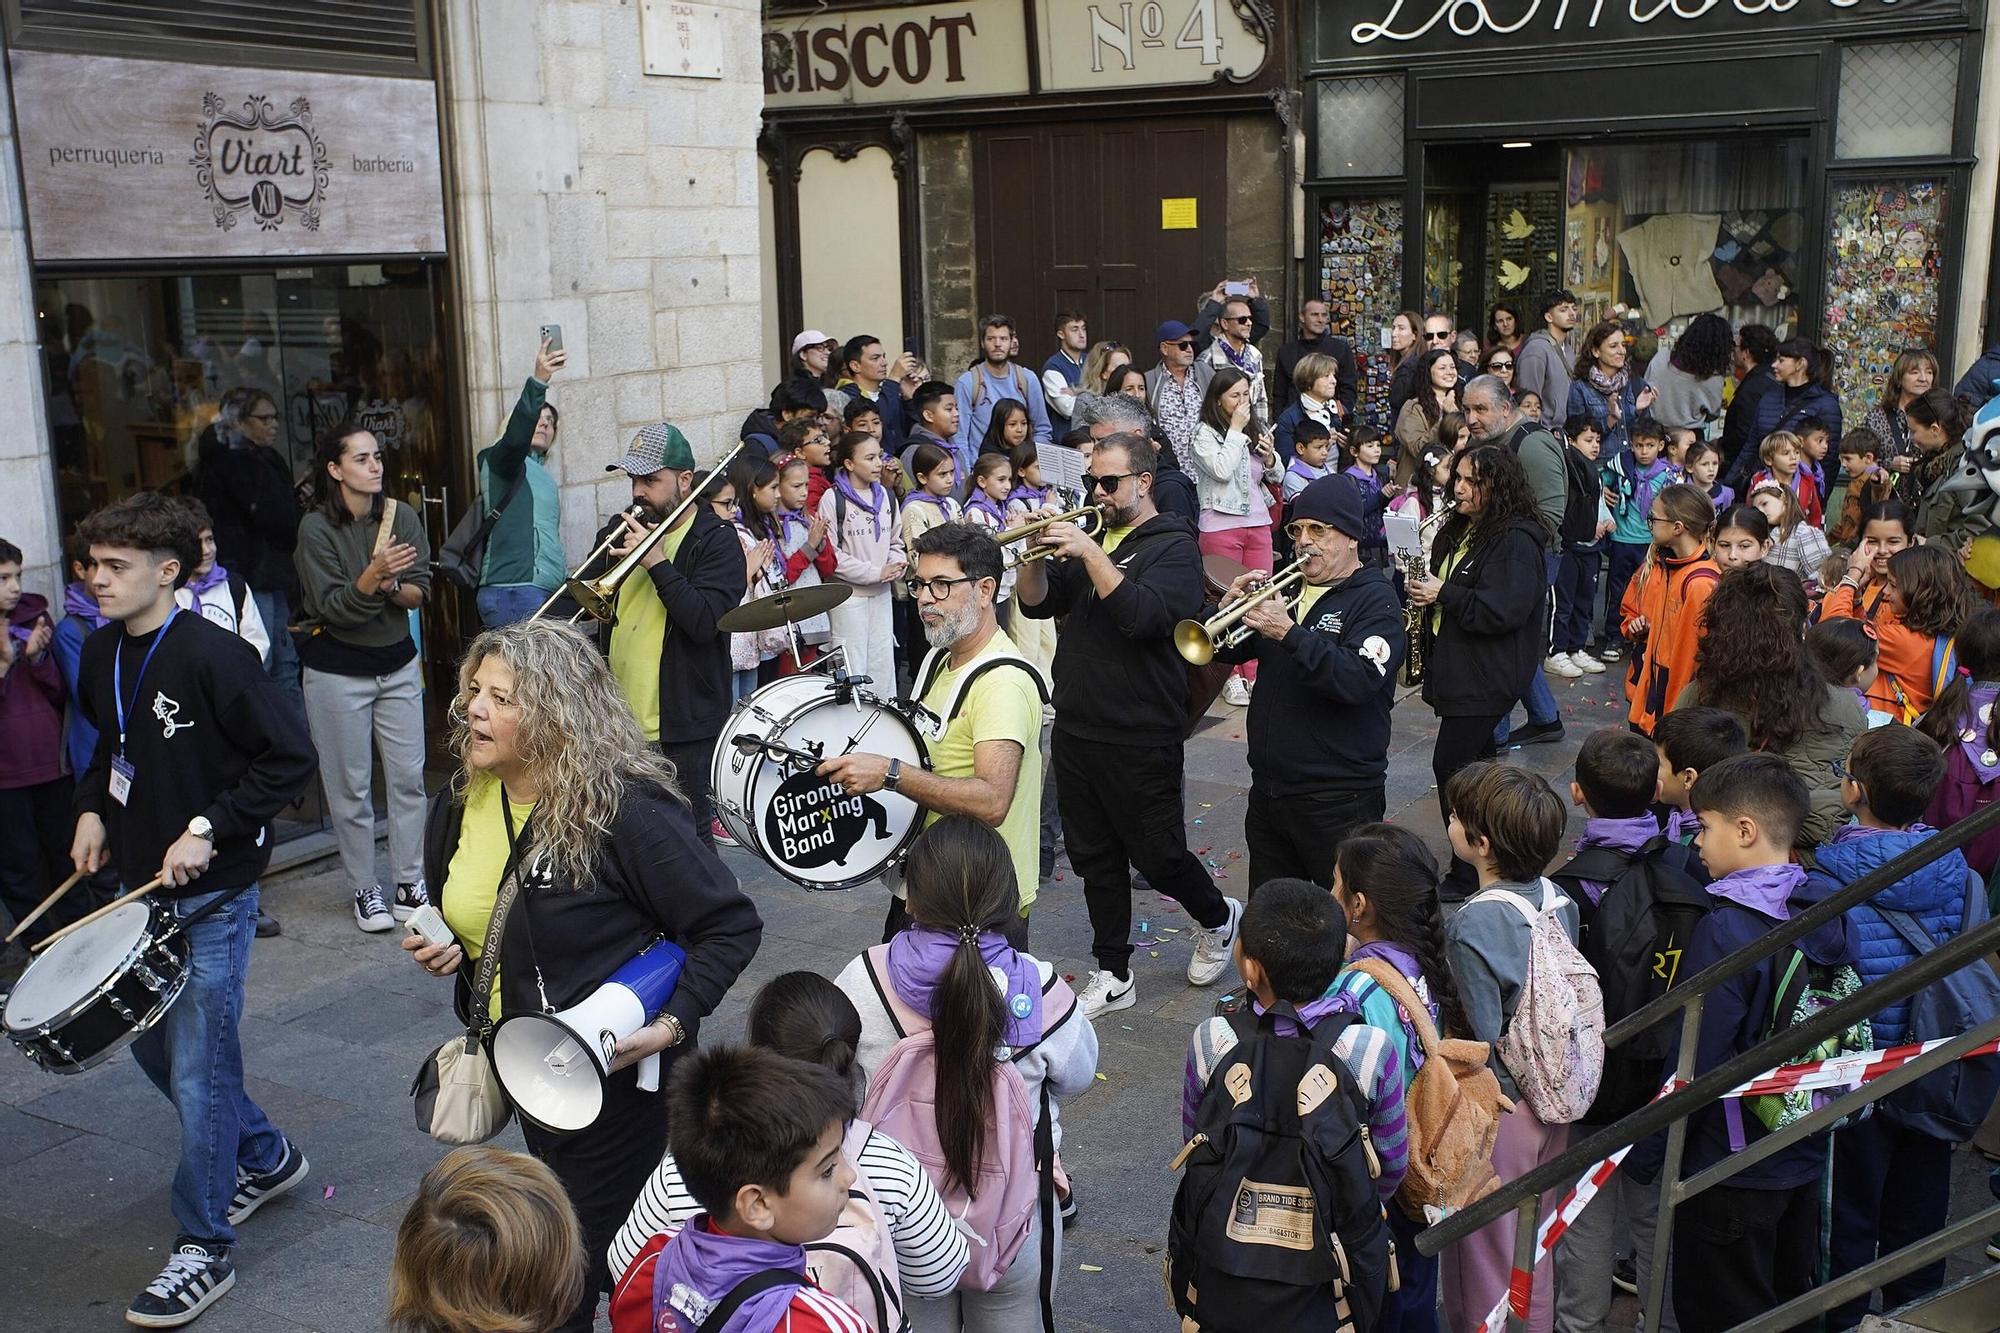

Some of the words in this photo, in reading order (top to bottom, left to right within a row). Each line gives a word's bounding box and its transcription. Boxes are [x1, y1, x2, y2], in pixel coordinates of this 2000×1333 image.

[49, 145, 164, 168] perruqueria
[221, 139, 305, 176] Viart
[352, 154, 414, 173] barberia
[773, 783, 843, 818] Girona
[777, 795, 864, 839] Marxing
[782, 823, 835, 861] Band
[1258, 1193, 1280, 1204] BRAND
[1281, 1196, 1297, 1206] TIDE
